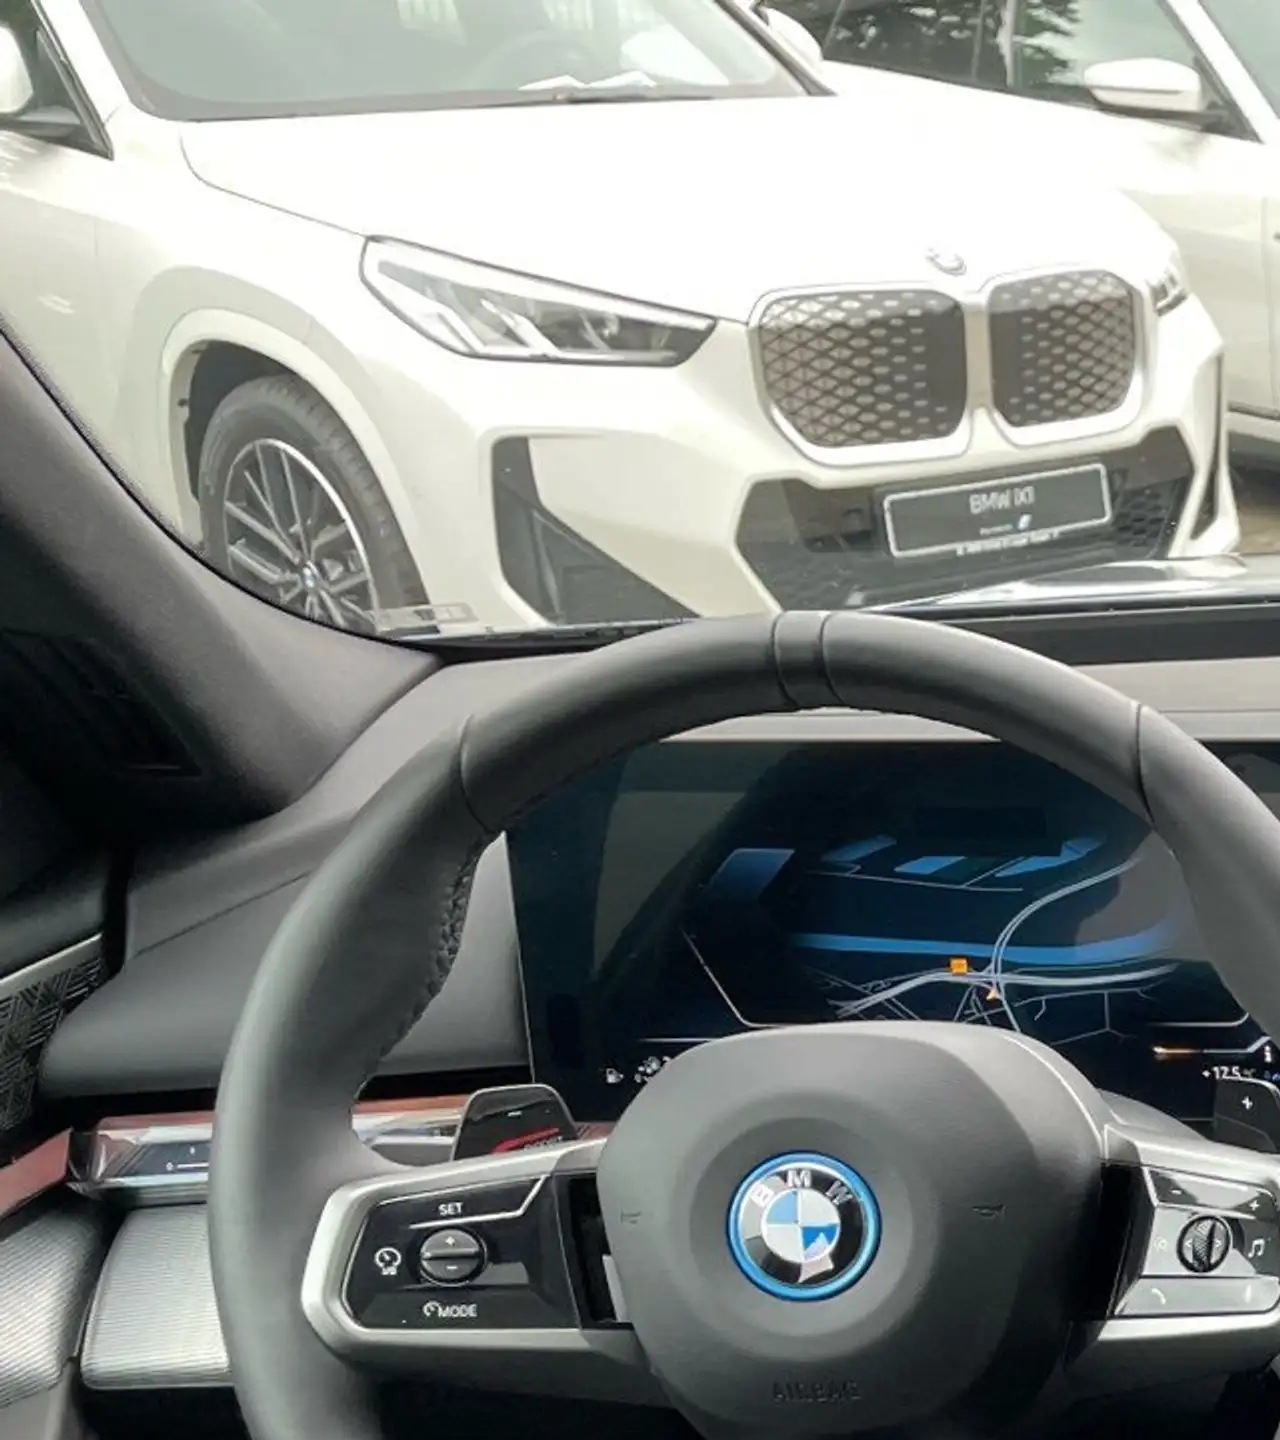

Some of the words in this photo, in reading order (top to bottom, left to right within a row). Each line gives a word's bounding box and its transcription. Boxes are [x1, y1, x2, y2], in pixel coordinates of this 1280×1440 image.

[969, 488, 1012, 515] BMW
[749, 1168, 854, 1208] BMW
[438, 1203, 464, 1216] SET
[438, 1303, 478, 1318] MODE
